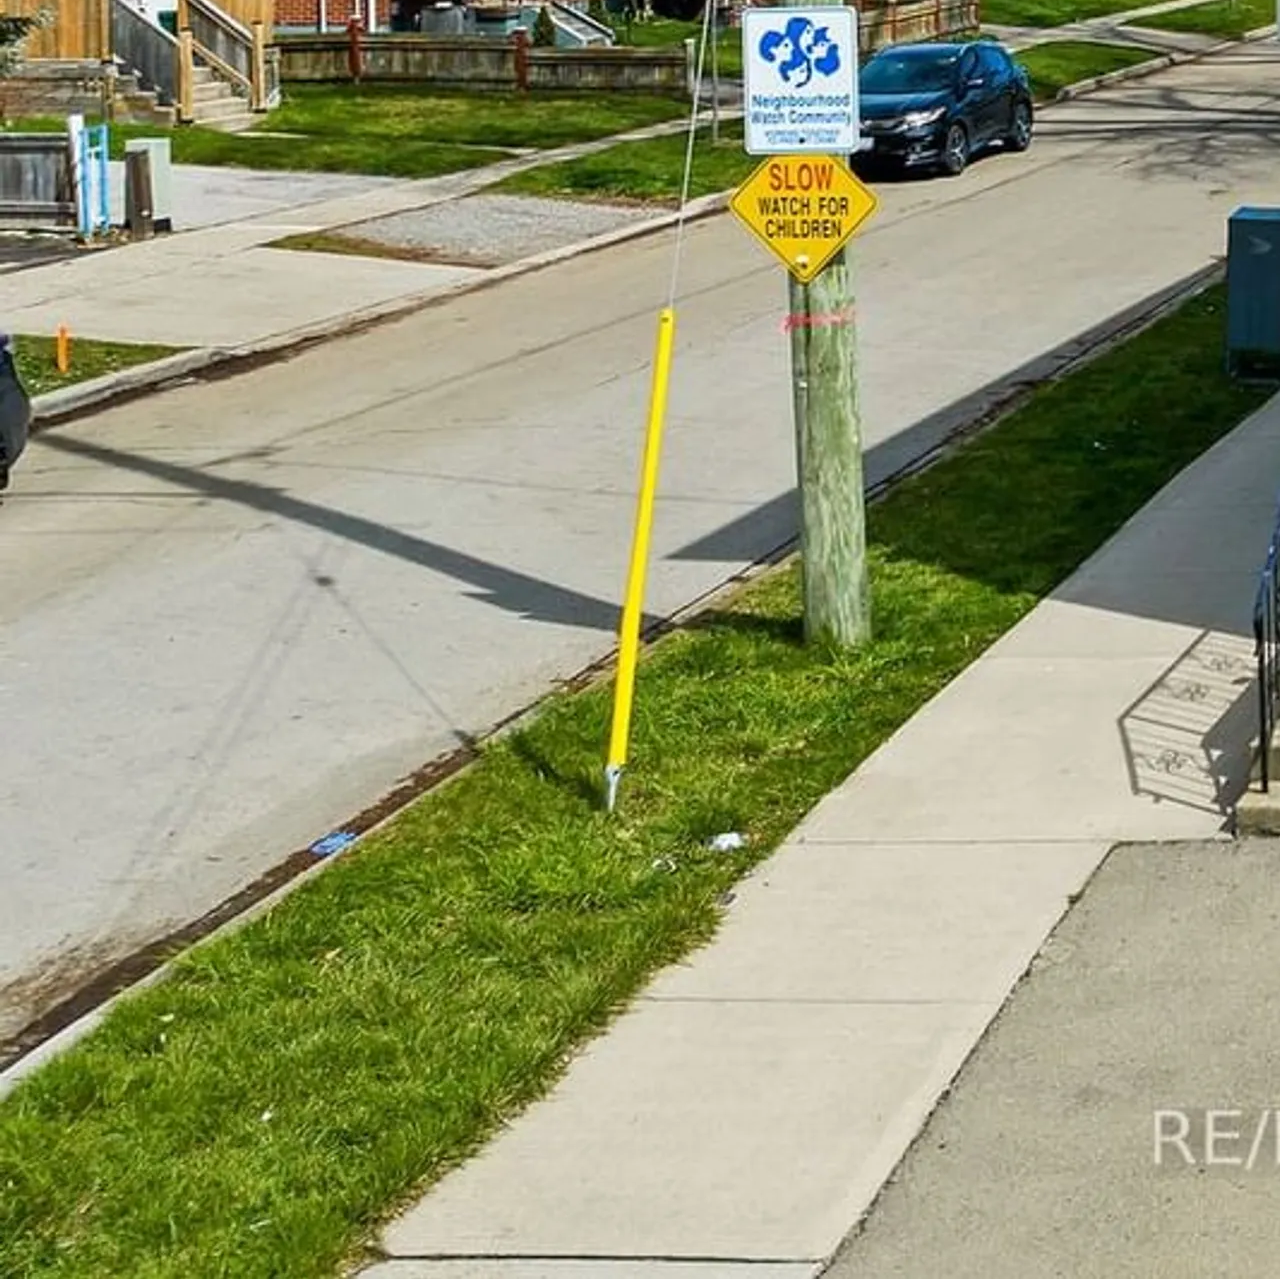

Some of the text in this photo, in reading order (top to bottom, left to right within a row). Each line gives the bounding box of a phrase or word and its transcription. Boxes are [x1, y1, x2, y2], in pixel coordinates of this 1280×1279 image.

[752, 94, 850, 110] Neighbourhood
[788, 110, 850, 126] Community
[768, 163, 834, 191] SLOW
[758, 197, 849, 215] WATCH FOR
[765, 218, 842, 239] CHILDREN
